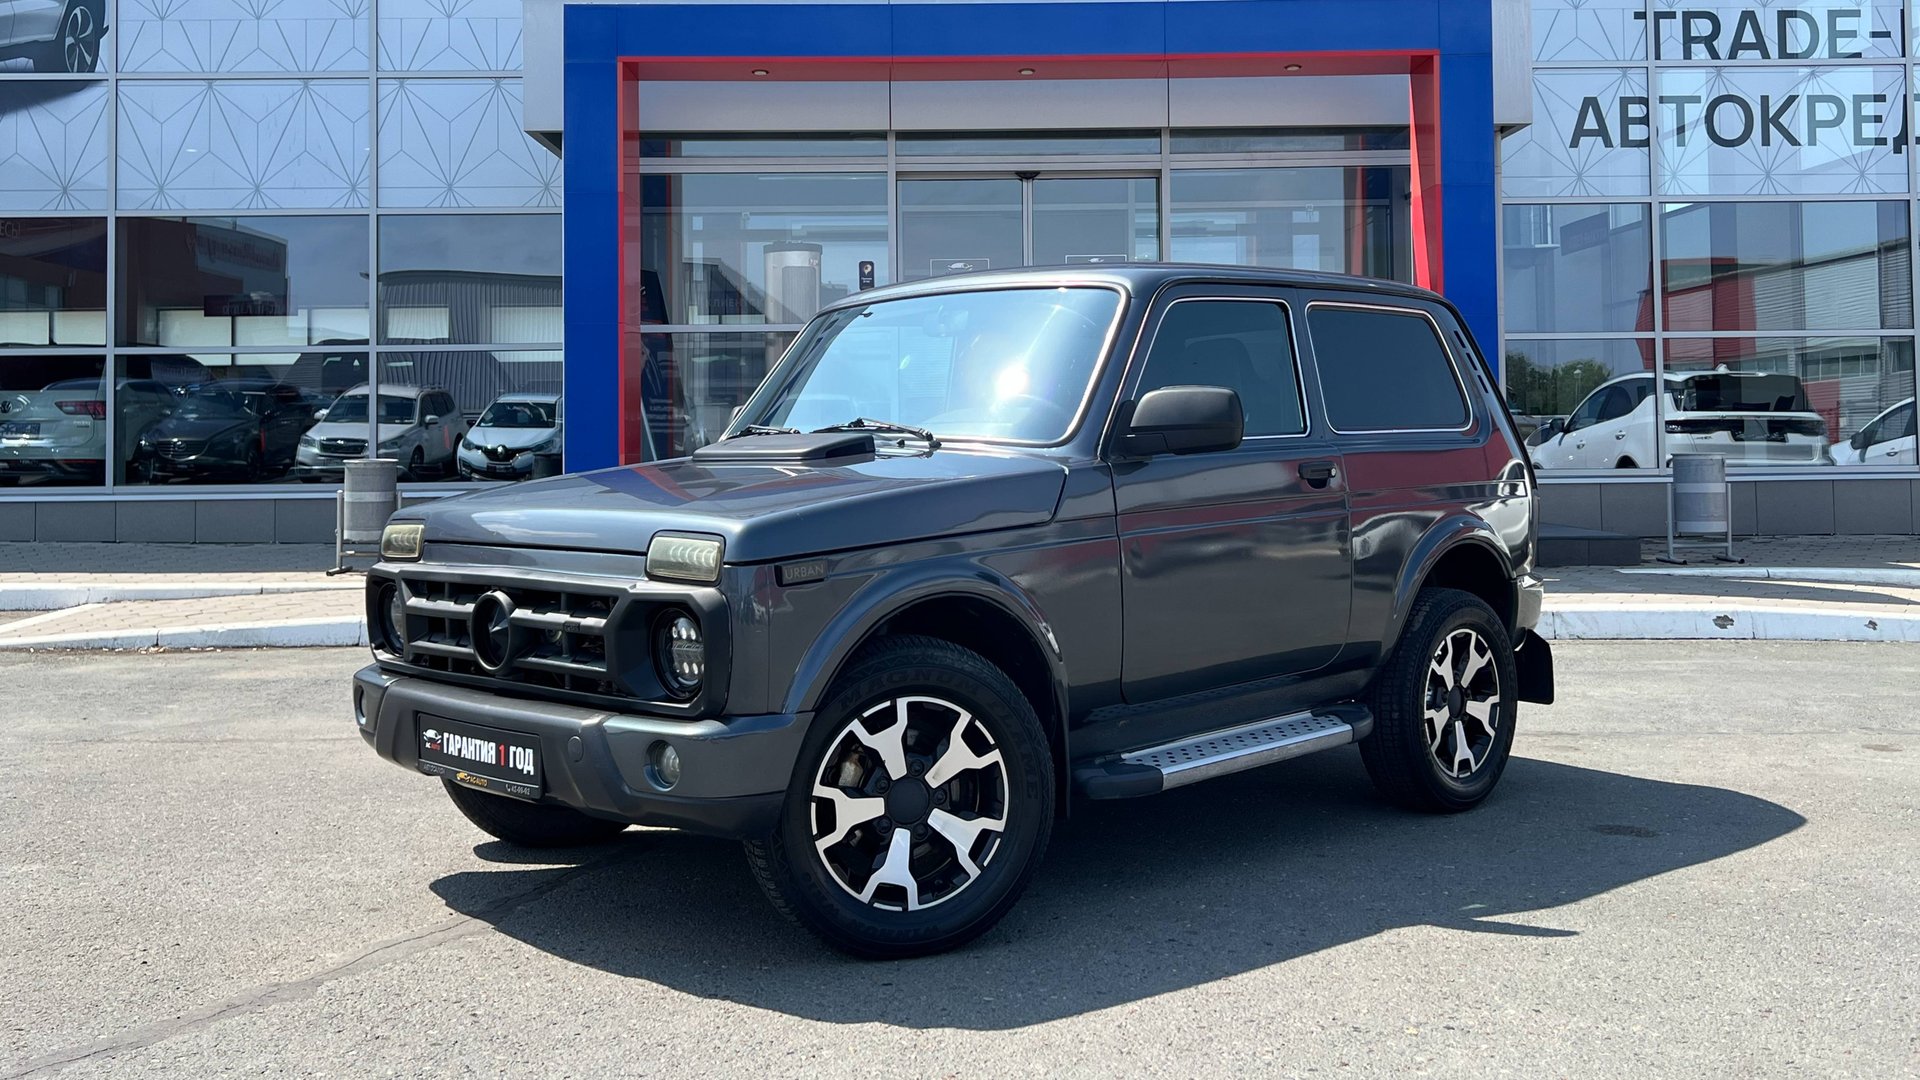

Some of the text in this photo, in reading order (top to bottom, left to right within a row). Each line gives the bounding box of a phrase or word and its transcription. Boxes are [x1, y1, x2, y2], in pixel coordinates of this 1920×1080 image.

[784, 564, 824, 580] URBAN
[443, 732, 535, 775] ГАРАНТИЯ 1 ГОД
